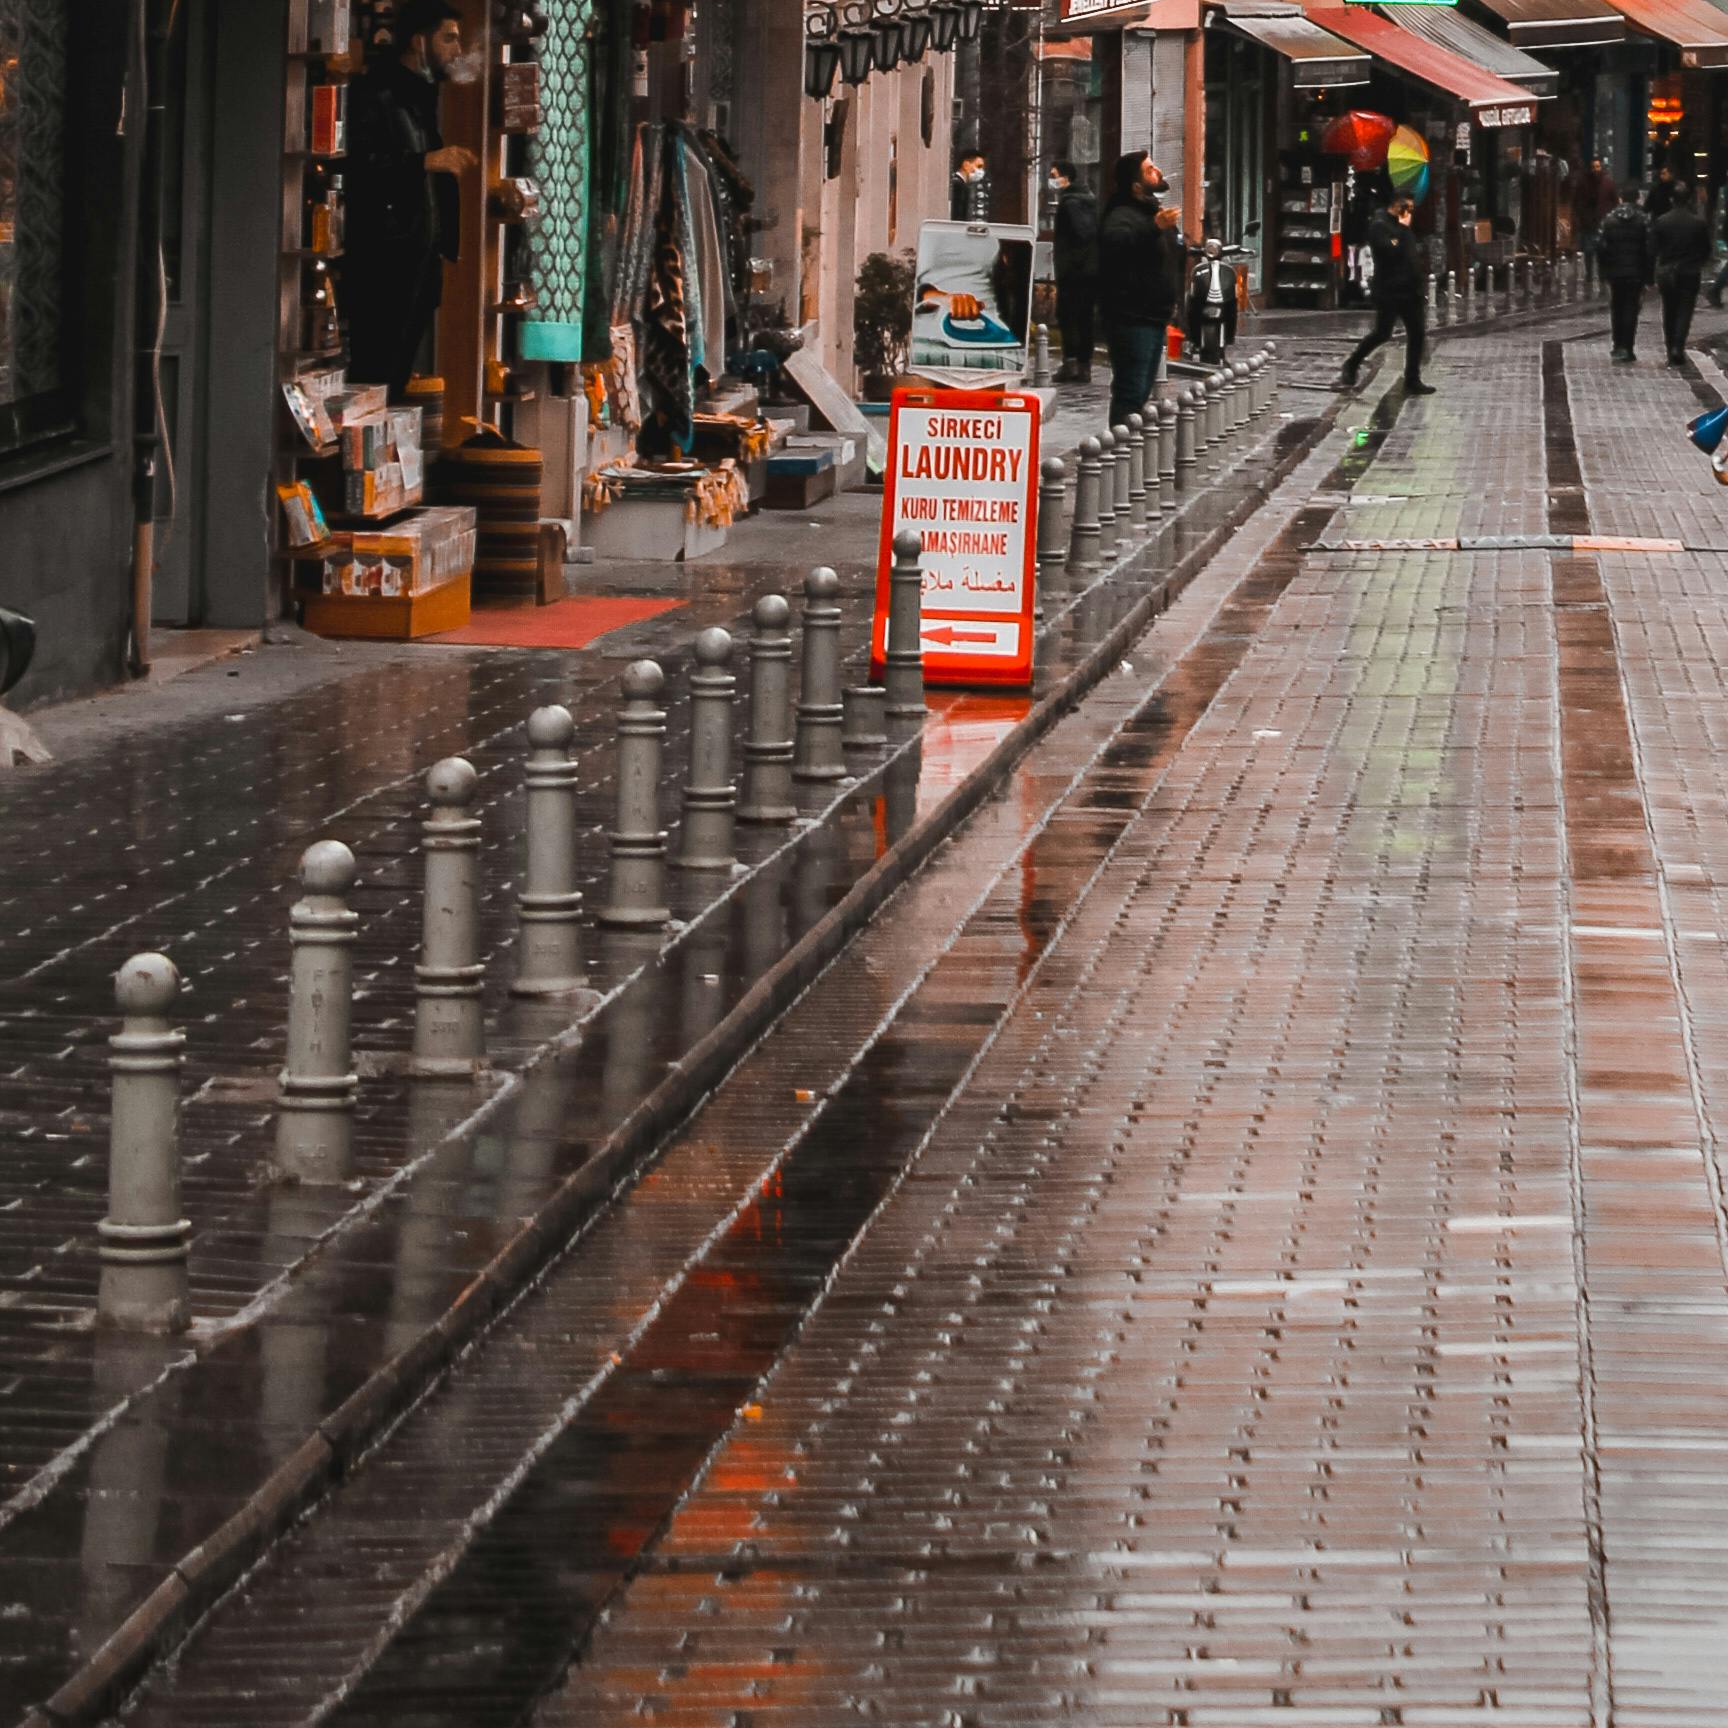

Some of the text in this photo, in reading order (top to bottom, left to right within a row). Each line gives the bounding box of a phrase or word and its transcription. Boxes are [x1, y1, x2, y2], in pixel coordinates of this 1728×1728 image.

[927, 414, 1002, 441] SİRKECİ
[902, 445, 1022, 482] LAUNDRY
[902, 496, 1018, 524] KURU TEMİZLEME
[920, 531, 1008, 559] AMAŞIRHANE
